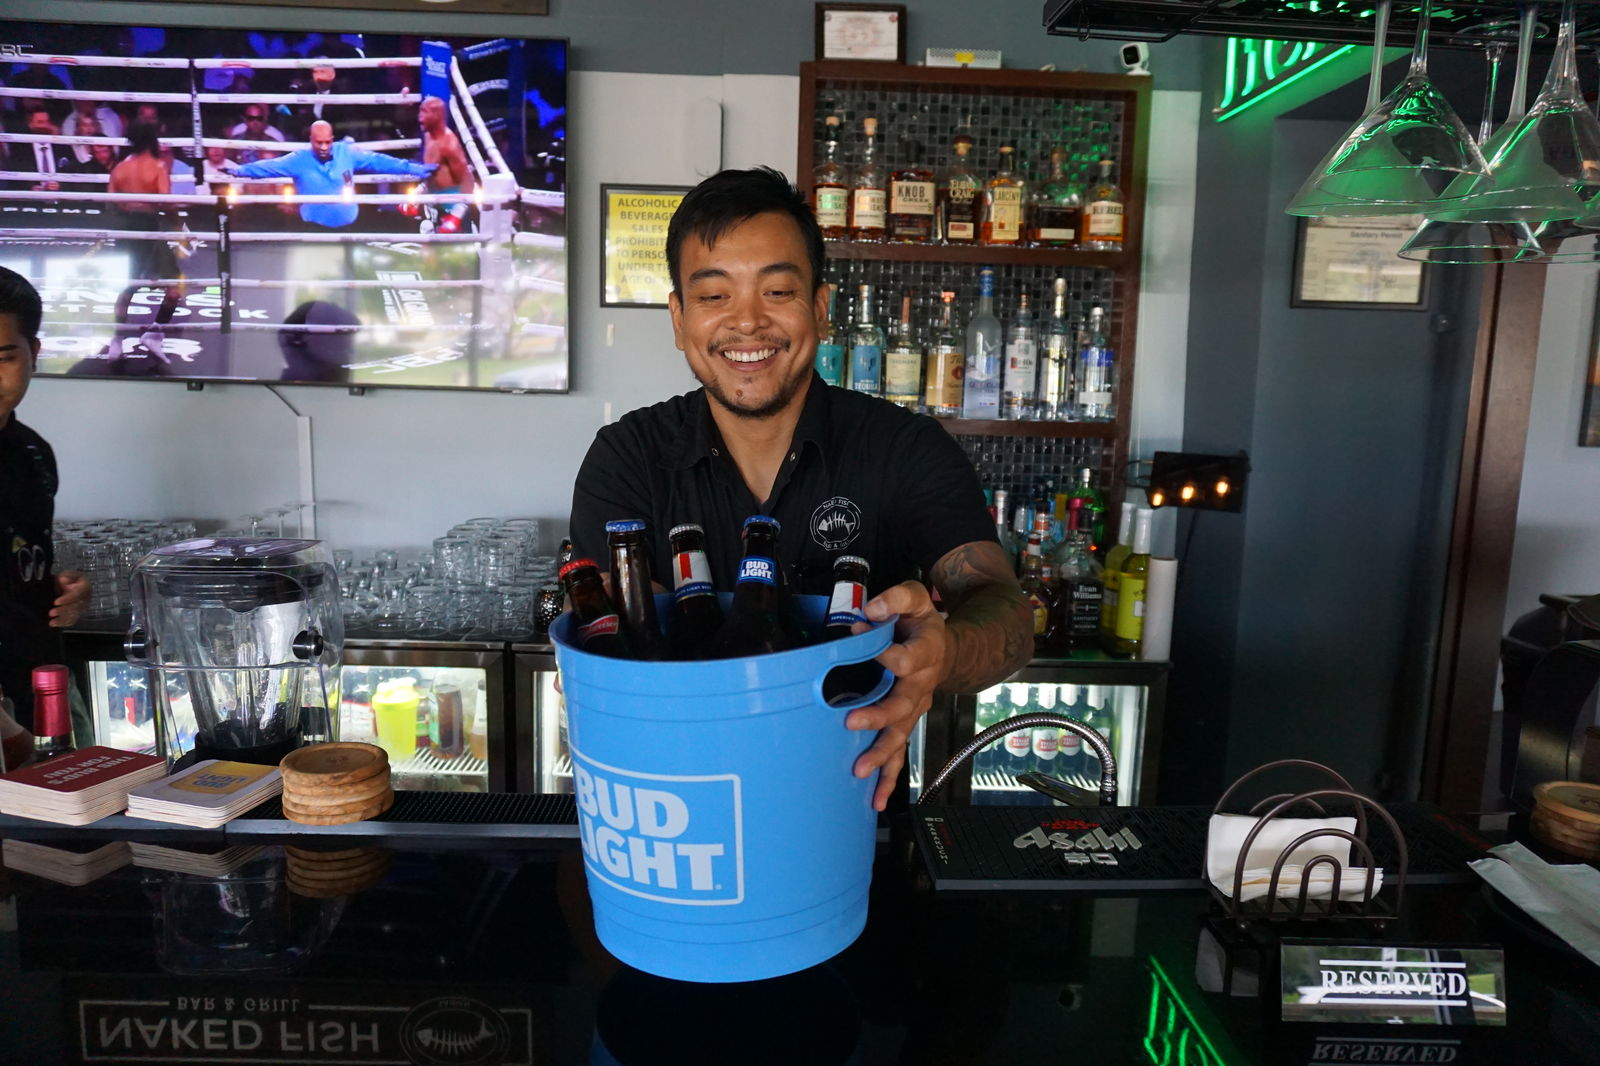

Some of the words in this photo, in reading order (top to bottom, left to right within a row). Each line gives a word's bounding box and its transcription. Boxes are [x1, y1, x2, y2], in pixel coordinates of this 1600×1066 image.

[898, 185, 925, 198] KNOB
[617, 197, 678, 209] ALCOHOLIC
[632, 224, 664, 234] SALES
[616, 236, 666, 247] PROHIBIT
[616, 248, 629, 258] TO
[617, 263, 655, 273] UNDER
[746, 560, 769, 570] BUD
[741, 569, 773, 579] LIGHT
[1079, 585, 1097, 593] Evan
[1073, 591, 1102, 599] Williams
[43, 763, 79, 779] YOU
[574, 760, 690, 839] BUD
[1013, 826, 1143, 852] Asahi
[576, 802, 725, 891] LIGHT
[1320, 969, 1467, 997] RESERVED
